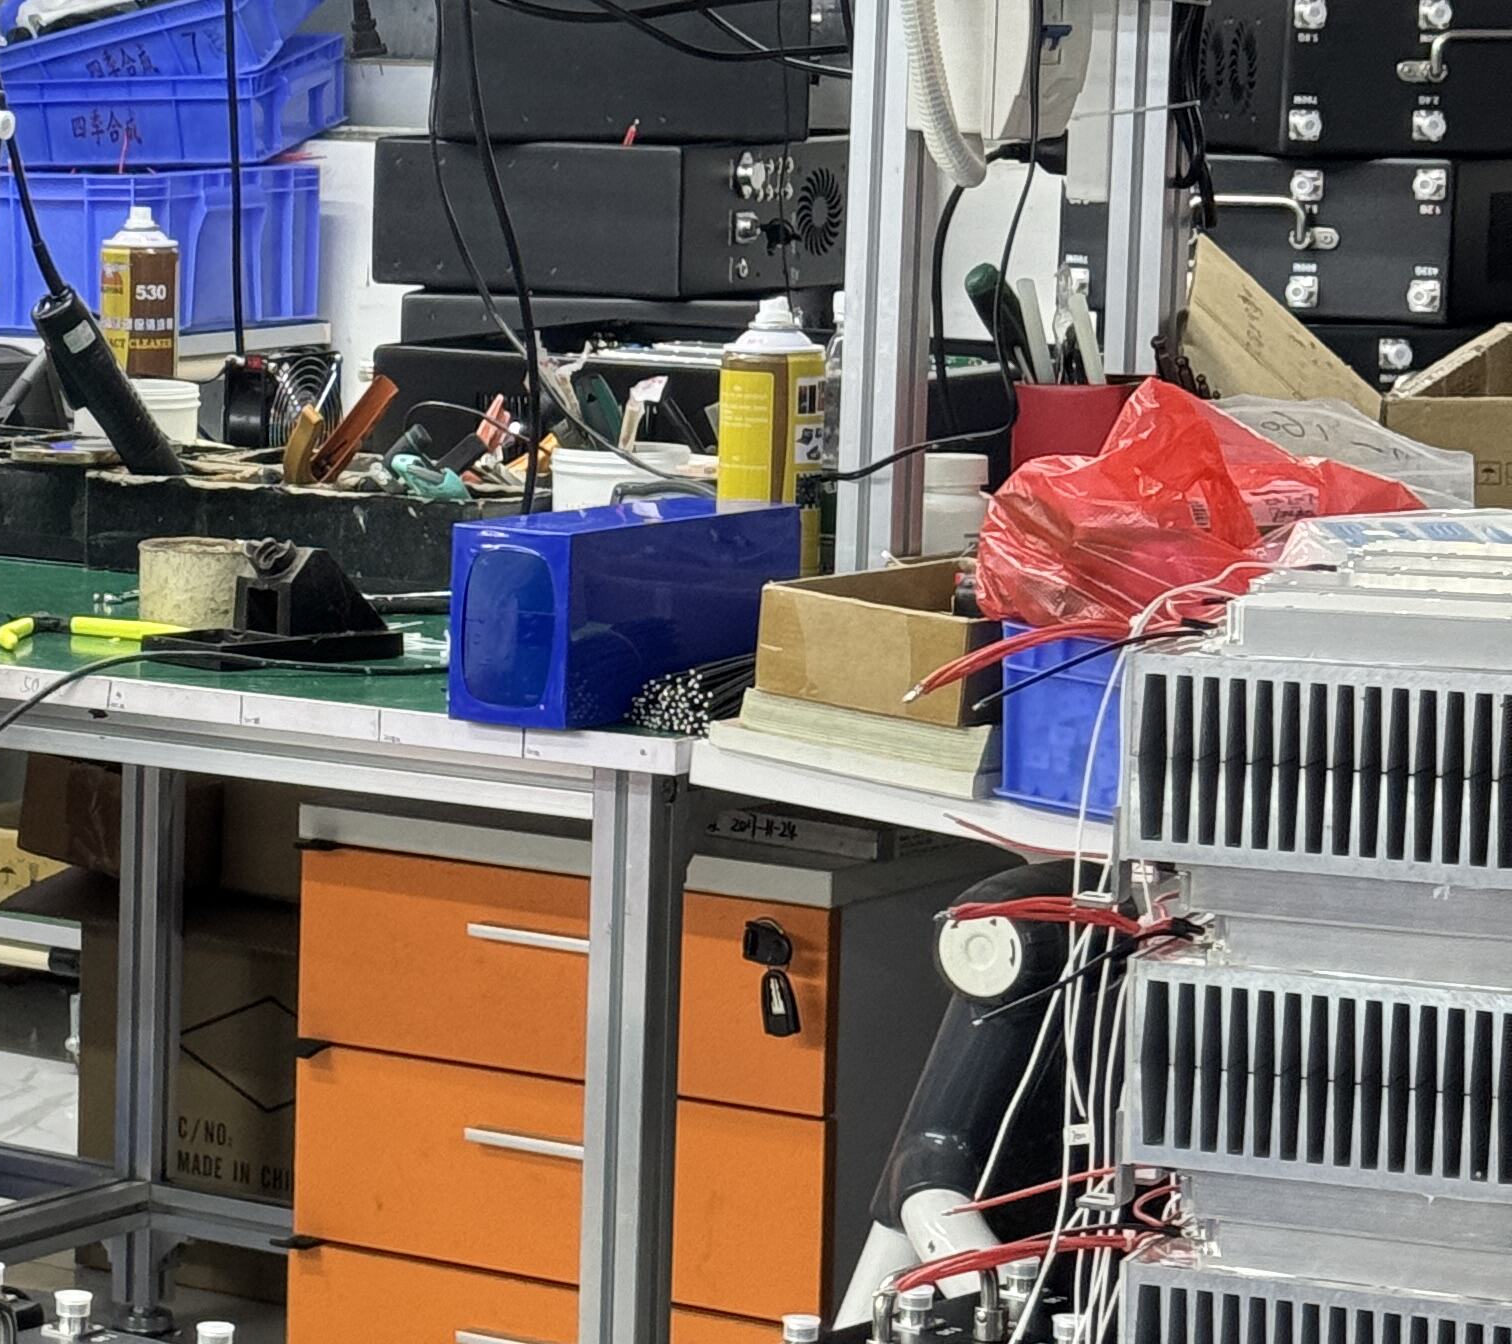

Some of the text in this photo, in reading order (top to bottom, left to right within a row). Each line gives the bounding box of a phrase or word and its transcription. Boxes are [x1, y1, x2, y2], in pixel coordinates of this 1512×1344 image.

[135, 284, 167, 301] 530
[176, 1150, 291, 1192] MADE IN CHI
